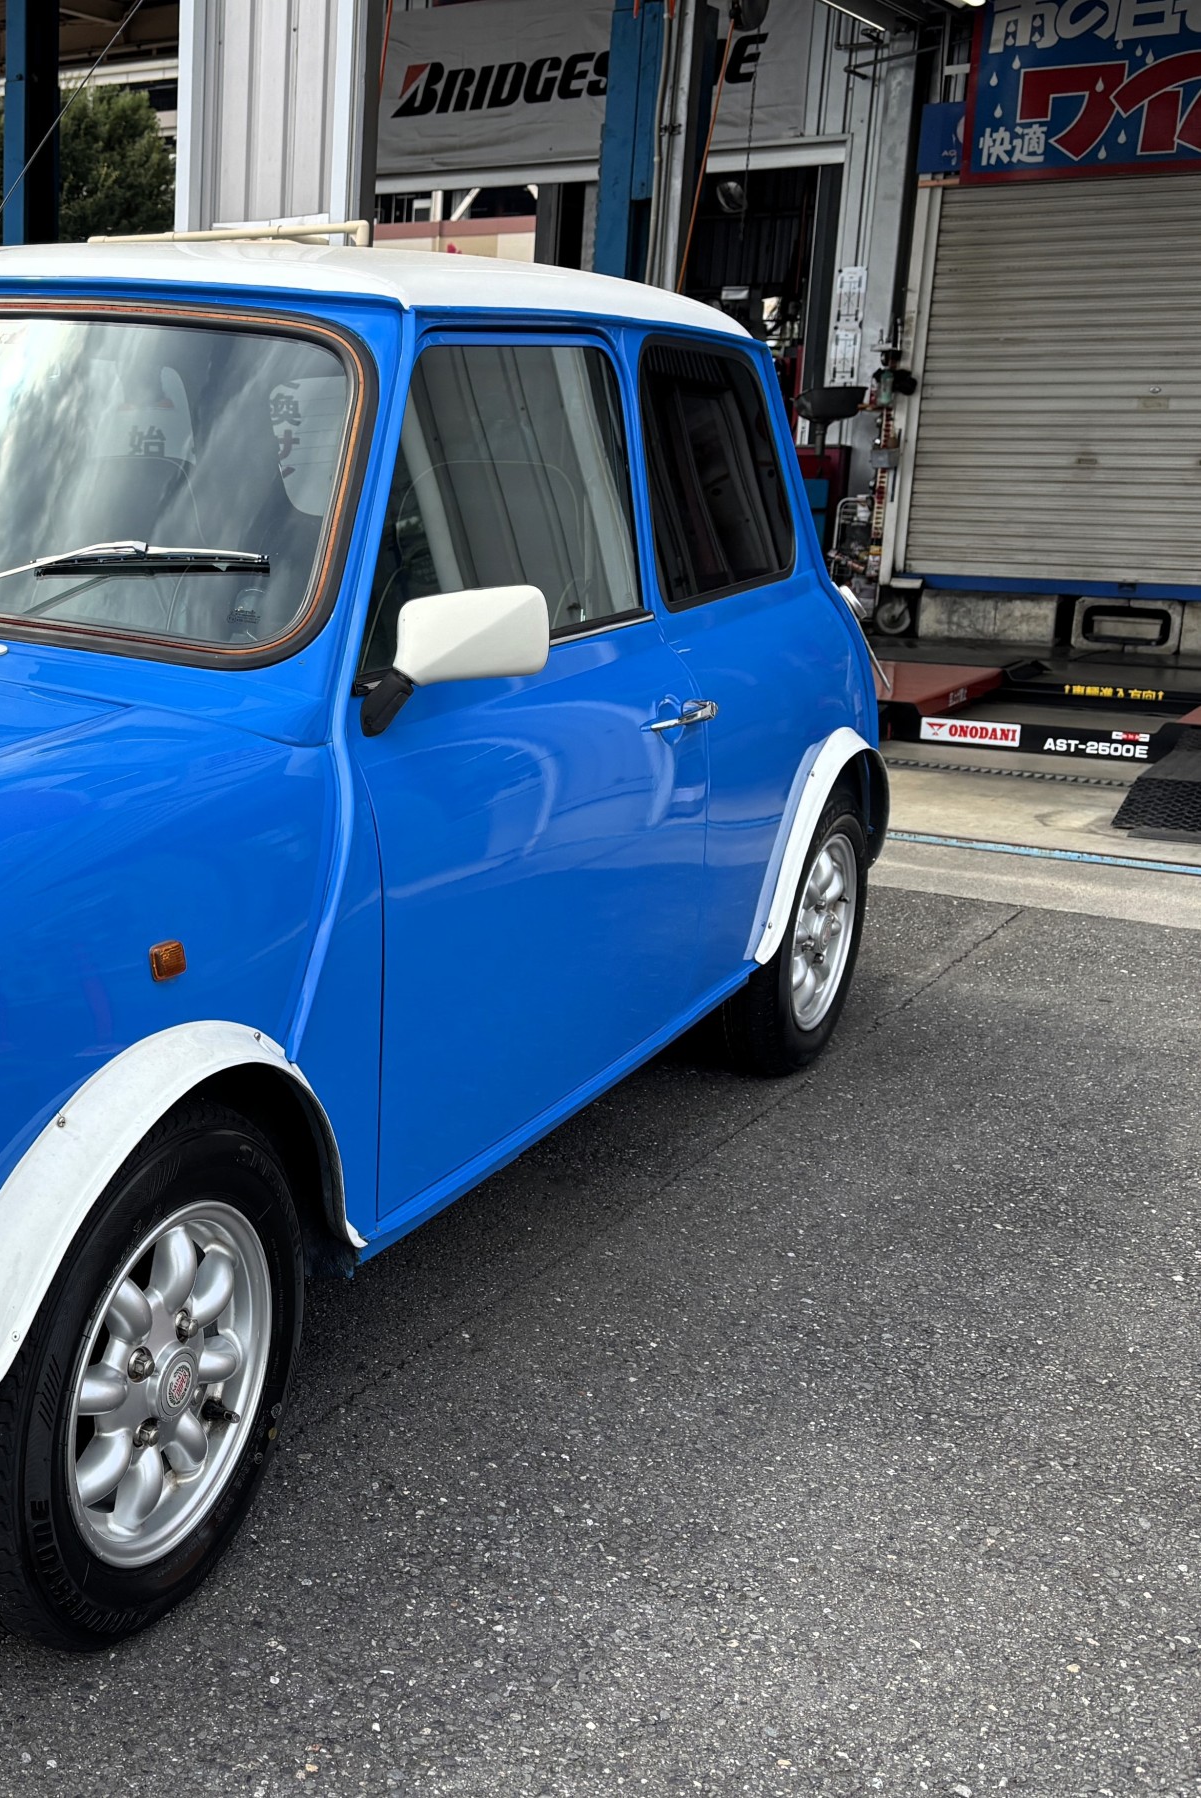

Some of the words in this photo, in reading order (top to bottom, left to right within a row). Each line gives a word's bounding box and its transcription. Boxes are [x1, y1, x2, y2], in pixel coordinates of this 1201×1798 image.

[1016, 50, 1201, 162] ワイ
[979, 124, 1048, 166] 快適
[948, 723, 1017, 744] ONODANI
[1043, 737, 1149, 760] AST-2500E
